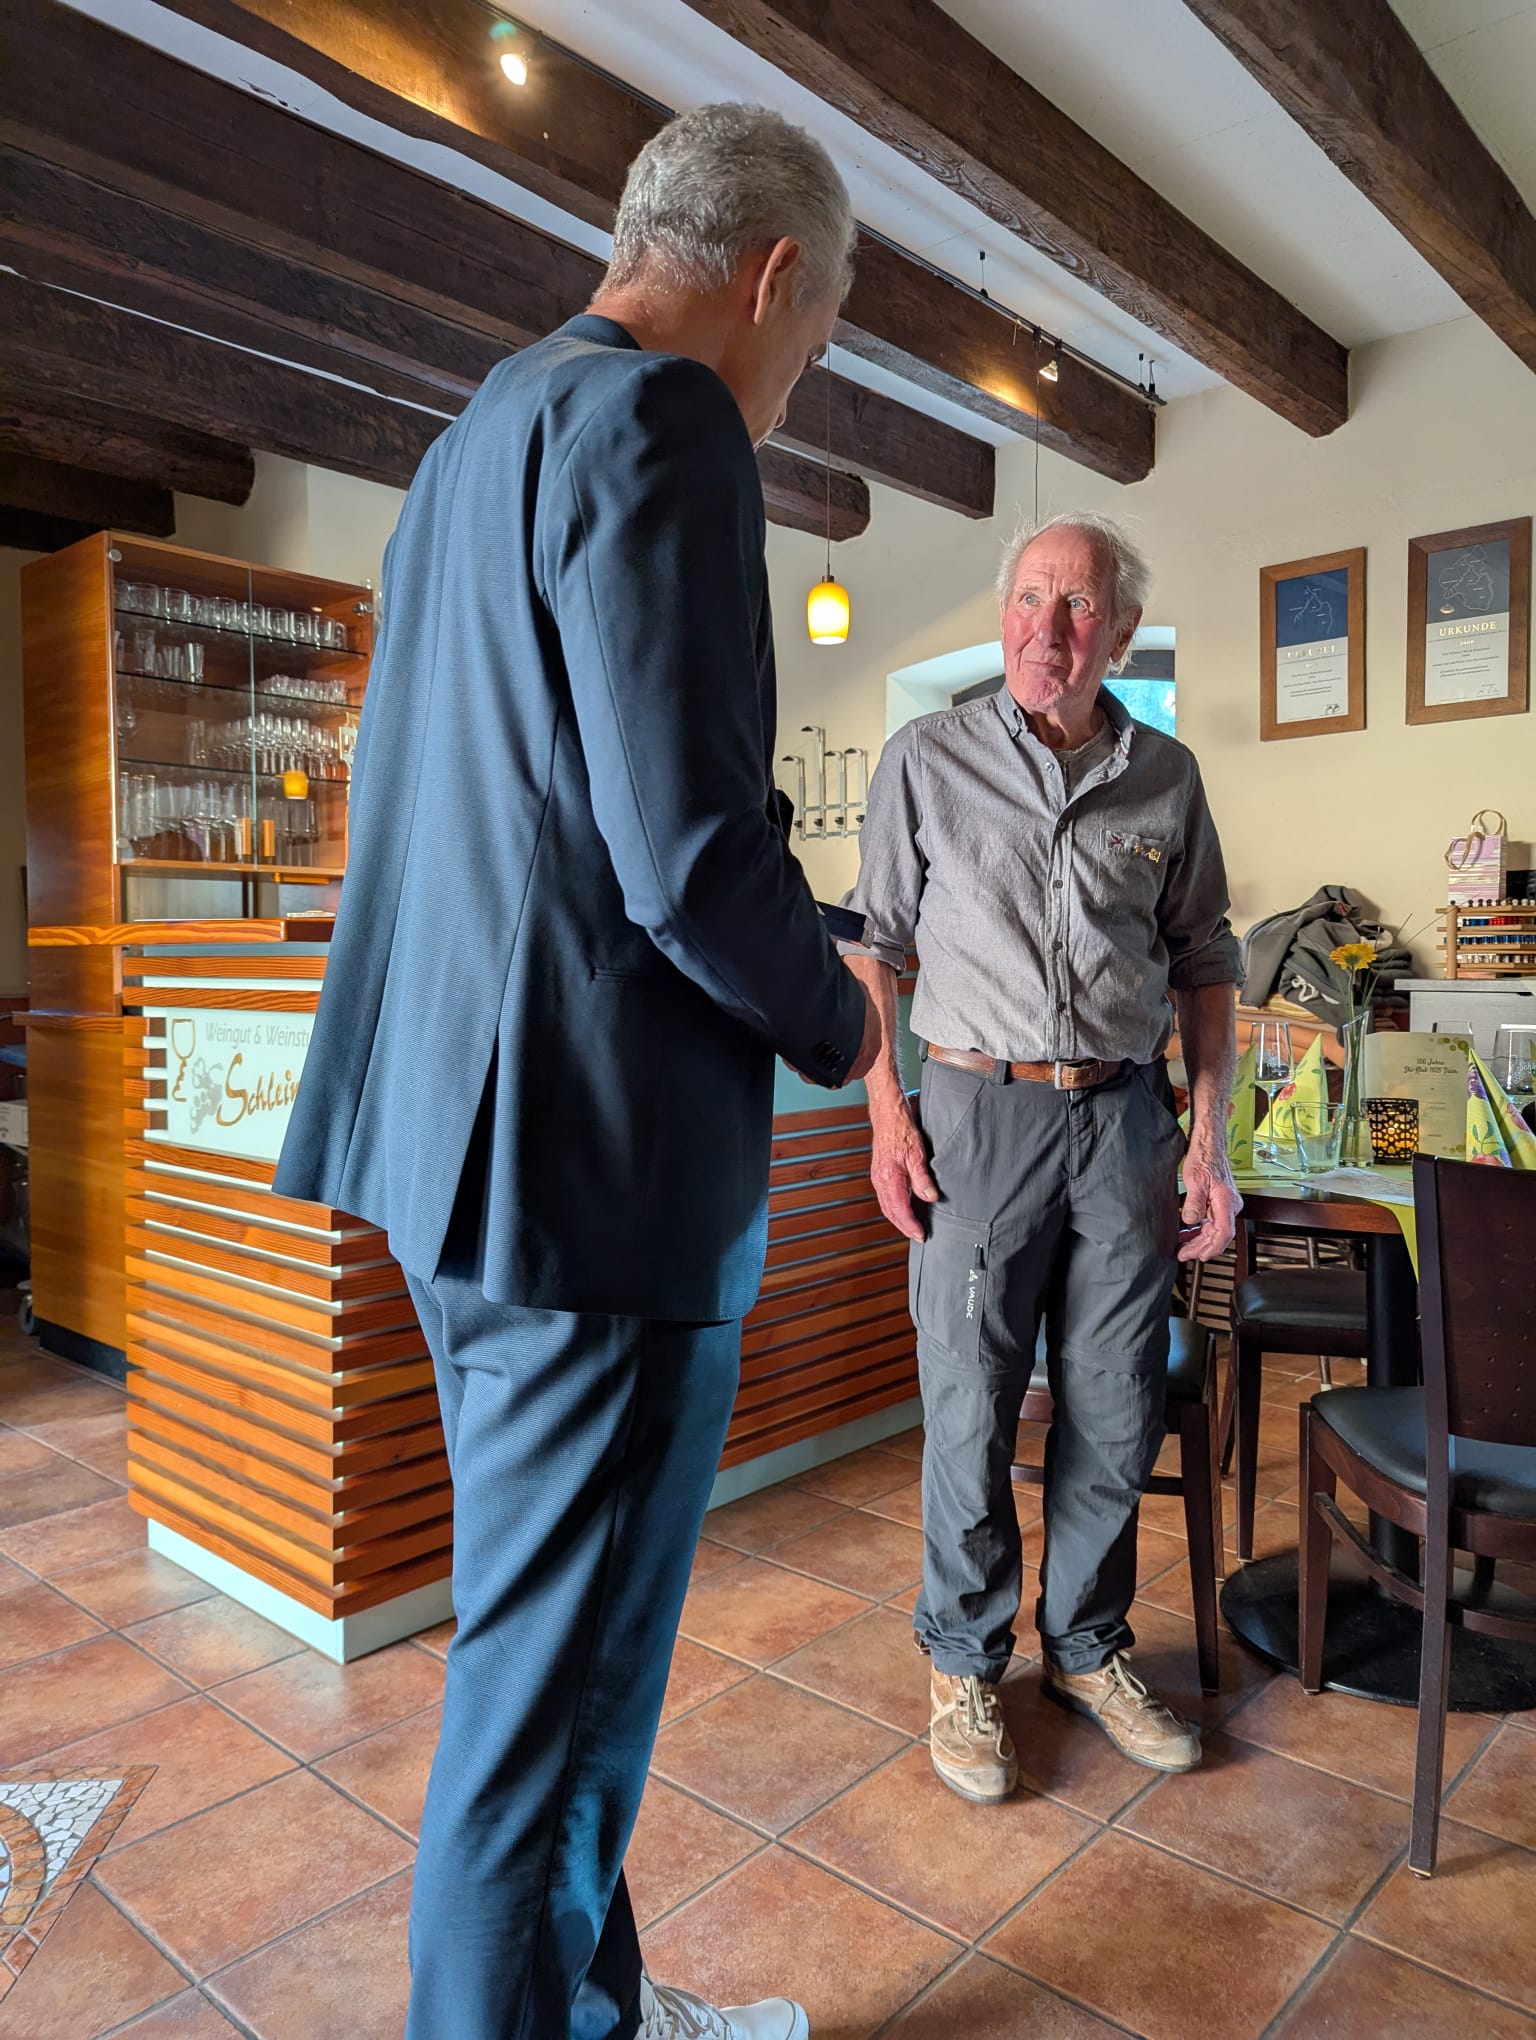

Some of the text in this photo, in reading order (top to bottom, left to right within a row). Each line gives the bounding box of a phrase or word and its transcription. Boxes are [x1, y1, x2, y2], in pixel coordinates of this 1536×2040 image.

[1440, 621, 1497, 637] URKUNDE
[206, 1022, 251, 1049] Weingut
[254, 1025, 262, 1044] &
[966, 1286, 976, 1319] VAUDE
